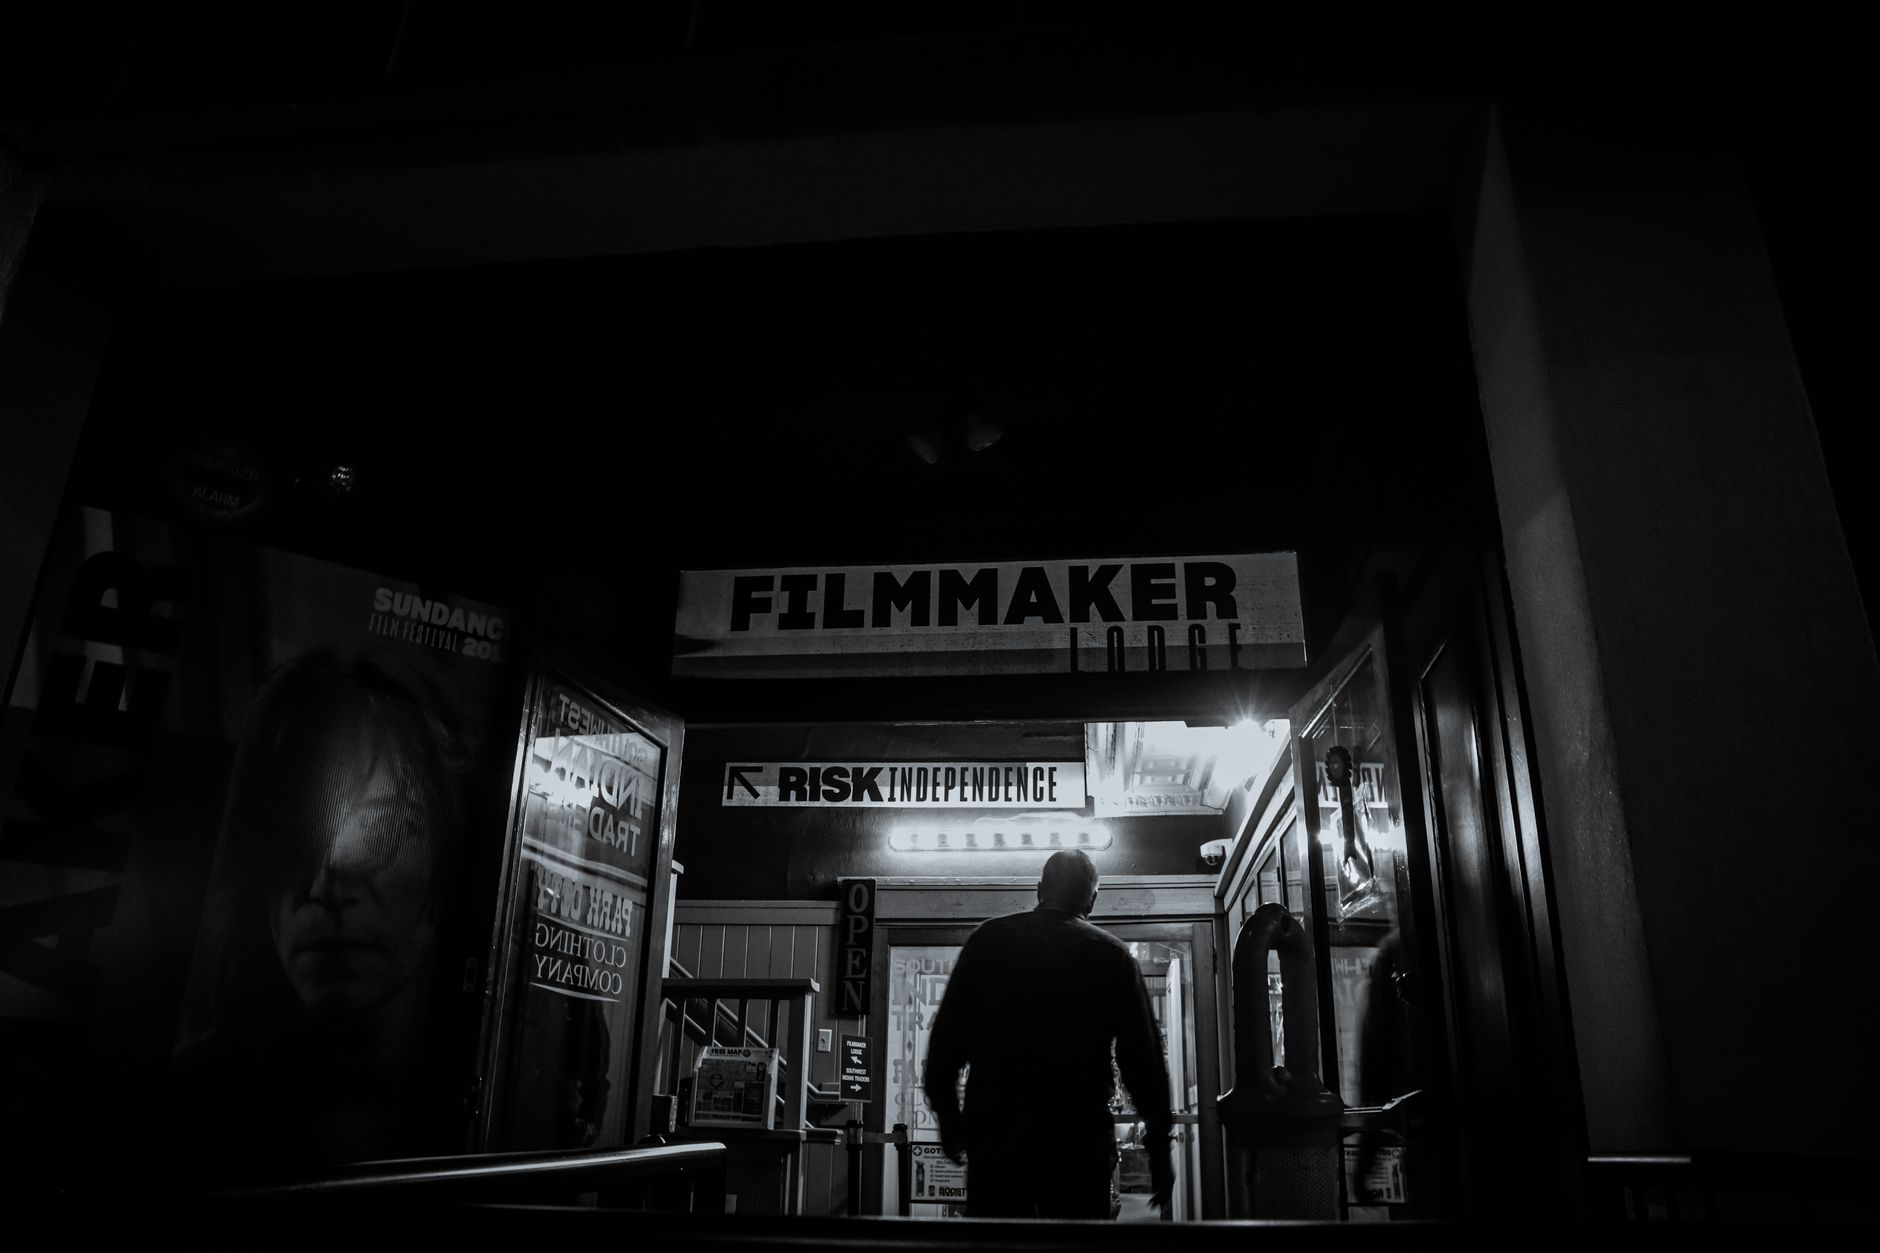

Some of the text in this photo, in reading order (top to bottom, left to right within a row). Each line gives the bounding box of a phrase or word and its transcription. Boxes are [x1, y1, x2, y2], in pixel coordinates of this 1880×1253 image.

[192, 482, 240, 509] ALARM
[373, 587, 505, 641] SUNDANC
[730, 561, 1238, 632] FILMMAKER
[368, 612, 401, 639] FILM
[402, 620, 458, 653] FESTIVAL
[1071, 623, 1242, 673] LODGE
[0, 550, 190, 1020] AKER
[777, 765, 1058, 804] RISK INDEPENDENCE
[842, 883, 870, 1012] OPEN
